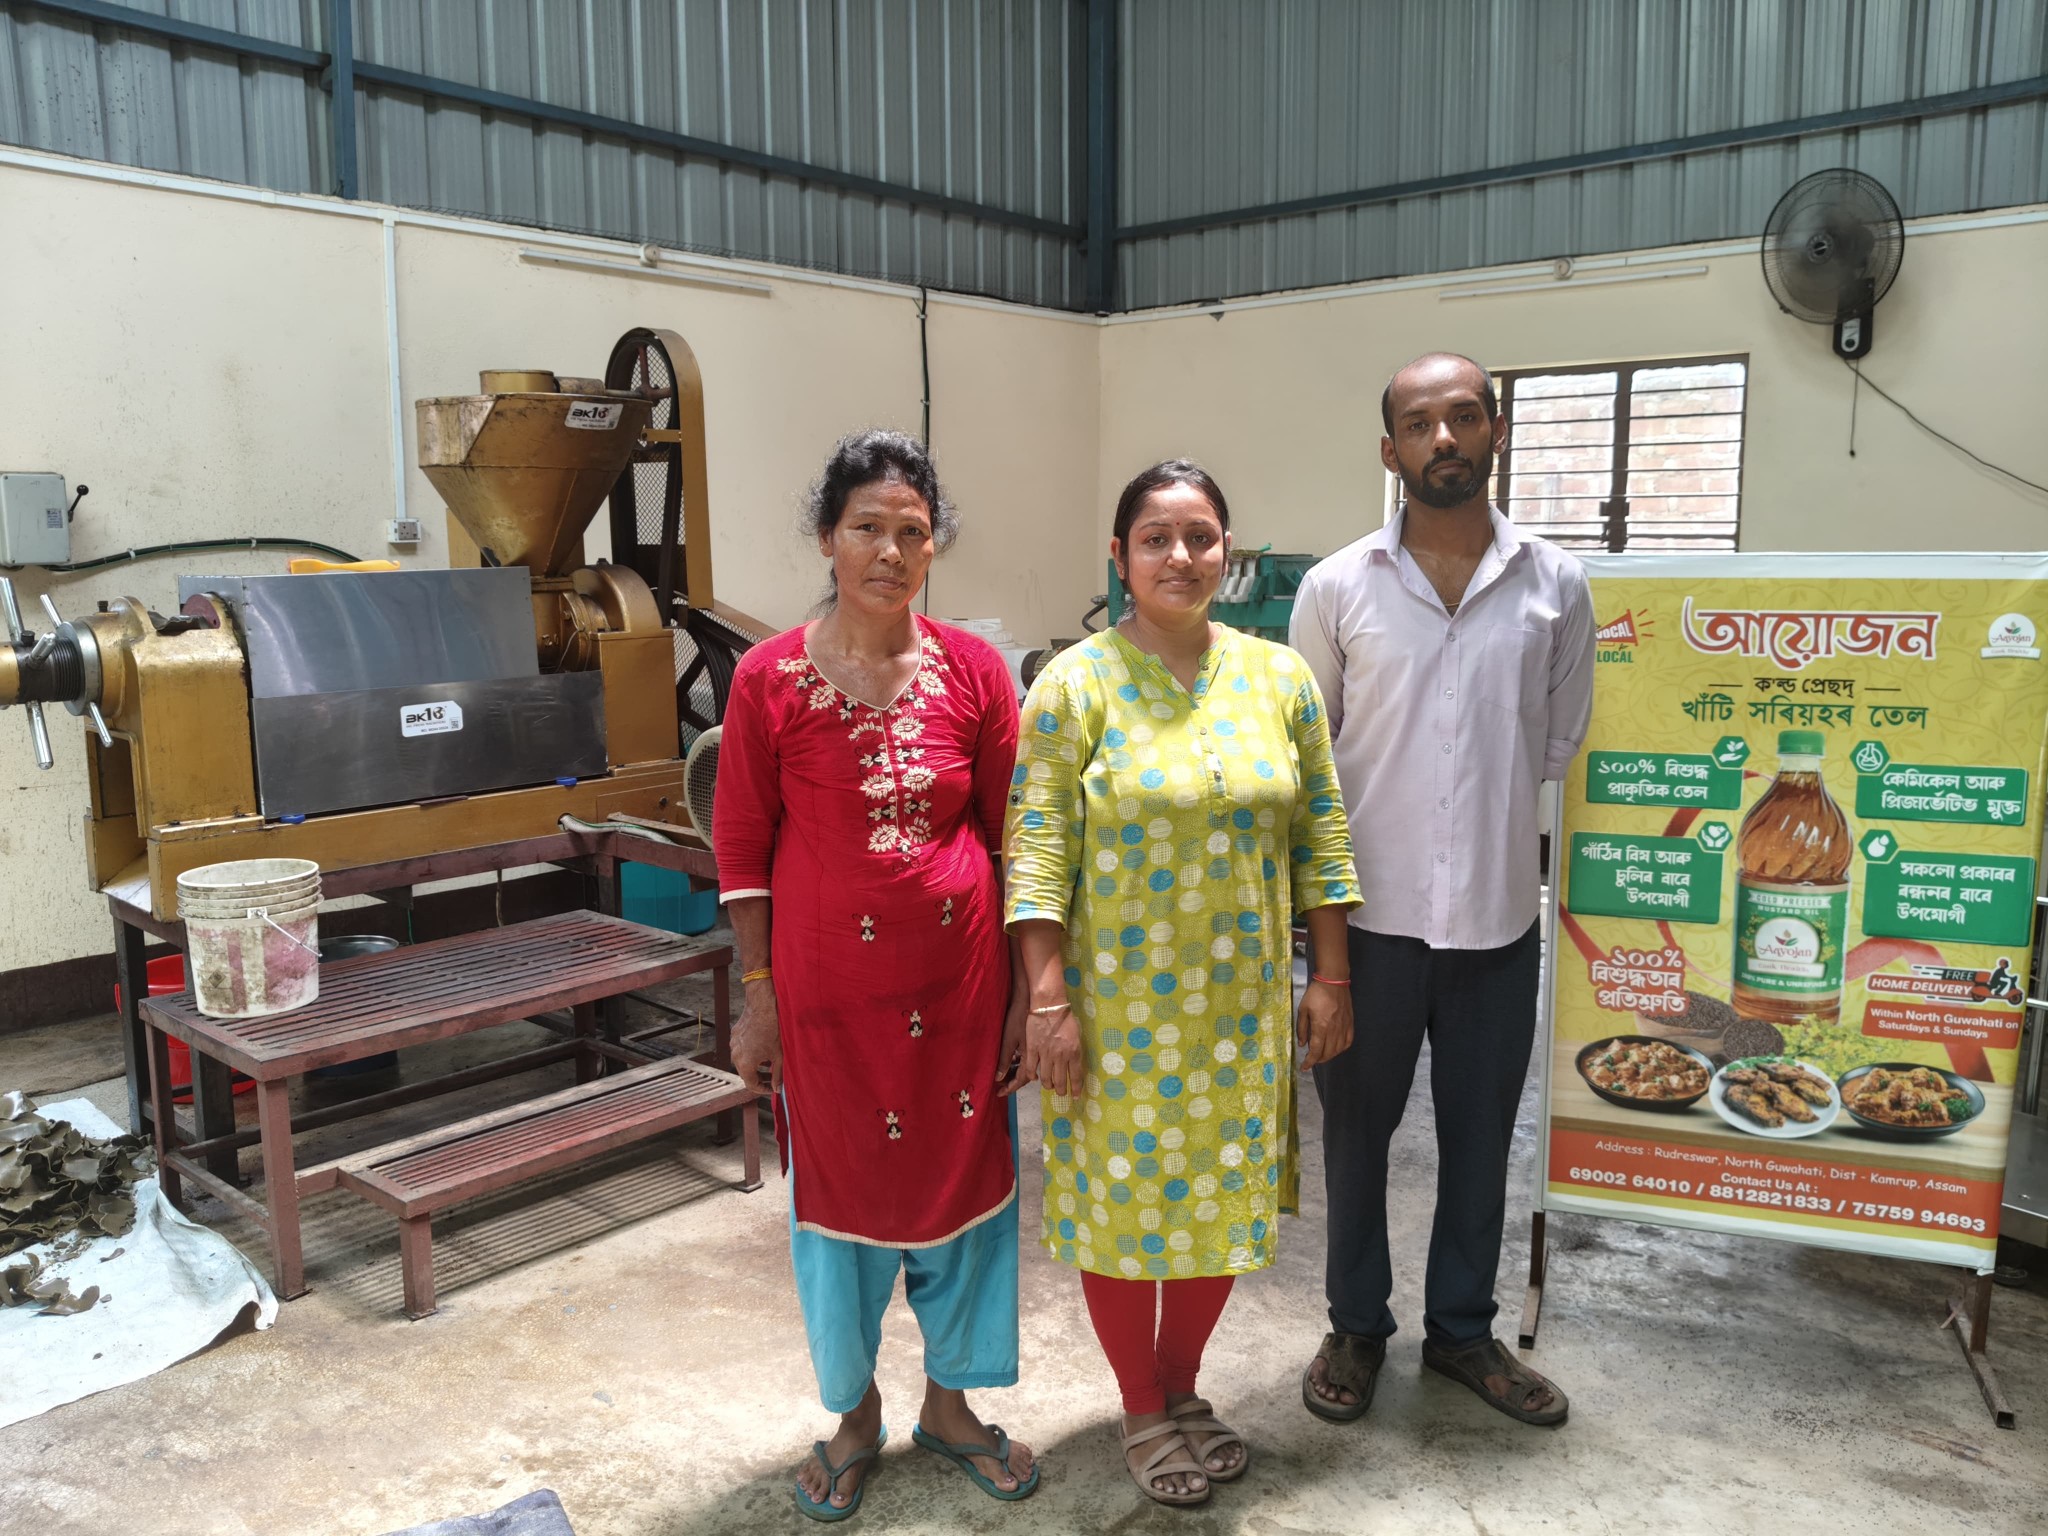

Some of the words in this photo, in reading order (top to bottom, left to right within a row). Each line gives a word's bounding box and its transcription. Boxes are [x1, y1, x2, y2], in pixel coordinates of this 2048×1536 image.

[1595, 621, 1633, 639] VOCAL
[1682, 597, 1941, 670] আয়োজন
[1596, 650, 1633, 663] LOCAL
[1867, 706, 1928, 729] তেল
[1598, 759, 1656, 774] ১০০%
[1665, 758, 1710, 780] বিশুদ্ধ
[1883, 768, 1960, 789] কেমিকেল
[1673, 785, 1709, 799] তেল
[1900, 862, 1955, 879] সকলো
[1757, 905, 1801, 915] MUSTARD
[1611, 949, 1682, 967] ১০০%
[1945, 970, 1975, 981] FREE
[1871, 978, 1910, 990] HOME
[1911, 981, 1973, 995] DELIVERY
[1870, 1008, 1903, 1019] Within
[1905, 1010, 1940, 1023] North
[1943, 1013, 2003, 1028] Guwahati
[2005, 1021, 2018, 1029] on
[1878, 1020, 1930, 1033] Saturdays
[1932, 1025, 1940, 1034] &
[1943, 1026, 1988, 1039] Sundays
[1595, 1141, 1643, 1155] Address
[1654, 1147, 1721, 1166] Rudreswar,
[1725, 1155, 1762, 1170] North
[1766, 1160, 1826, 1179] Guwahati,
[1830, 1167, 1856, 1181] Dist
[1870, 1173, 1920, 1190] Kamrup,
[1925, 1180, 1967, 1195] Assam
[1721, 1172, 1771, 1188] Contact
[1775, 1180, 1793, 1192] Us
[1796, 1181, 1810, 1193] At
[1569, 1167, 1627, 1185] 69002
[1632, 1175, 1691, 1193] 64010
[1709, 1184, 1831, 1211] 8812821833
[1852, 1201, 1914, 1221] 75759
[1920, 1210, 1986, 1232] 94693
